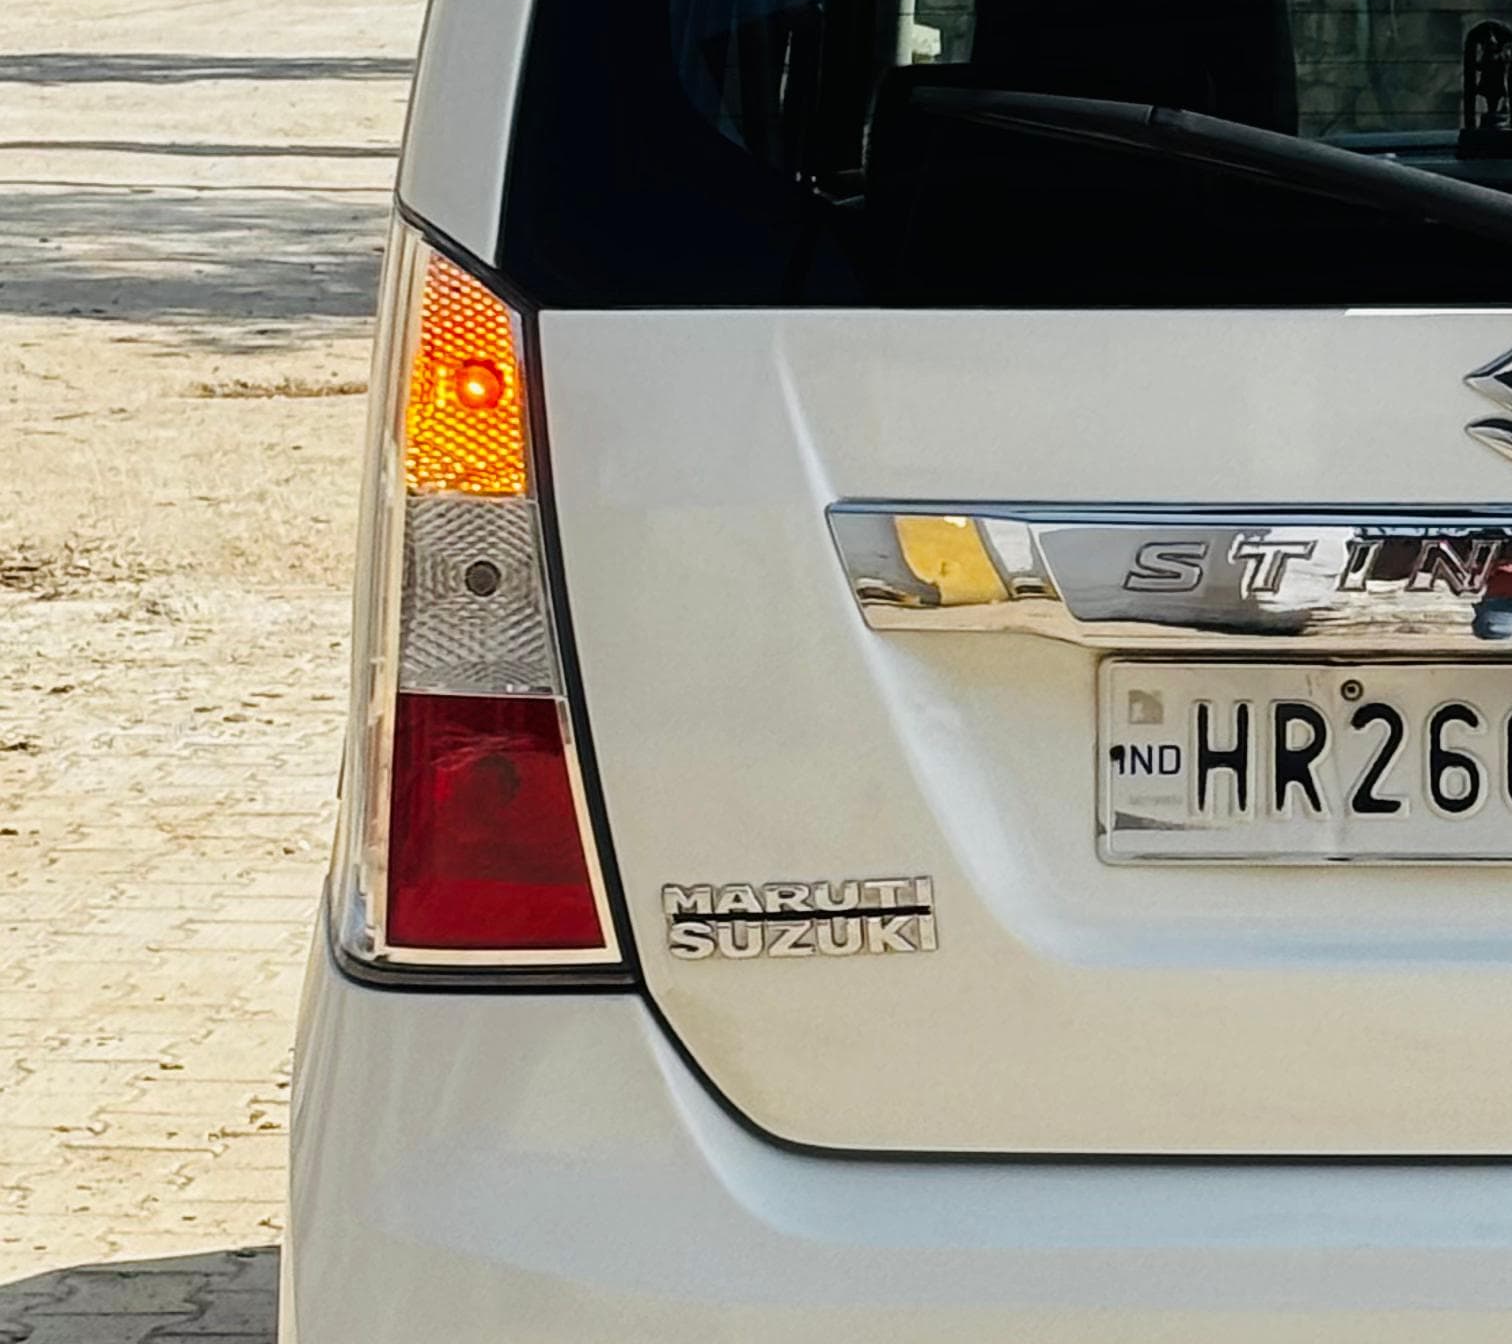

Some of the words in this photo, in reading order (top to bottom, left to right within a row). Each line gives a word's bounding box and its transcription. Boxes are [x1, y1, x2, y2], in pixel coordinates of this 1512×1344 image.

[1116, 744, 1182, 775] IND
[661, 875, 935, 914] MARUTI
[669, 913, 939, 959] SUZUKI
